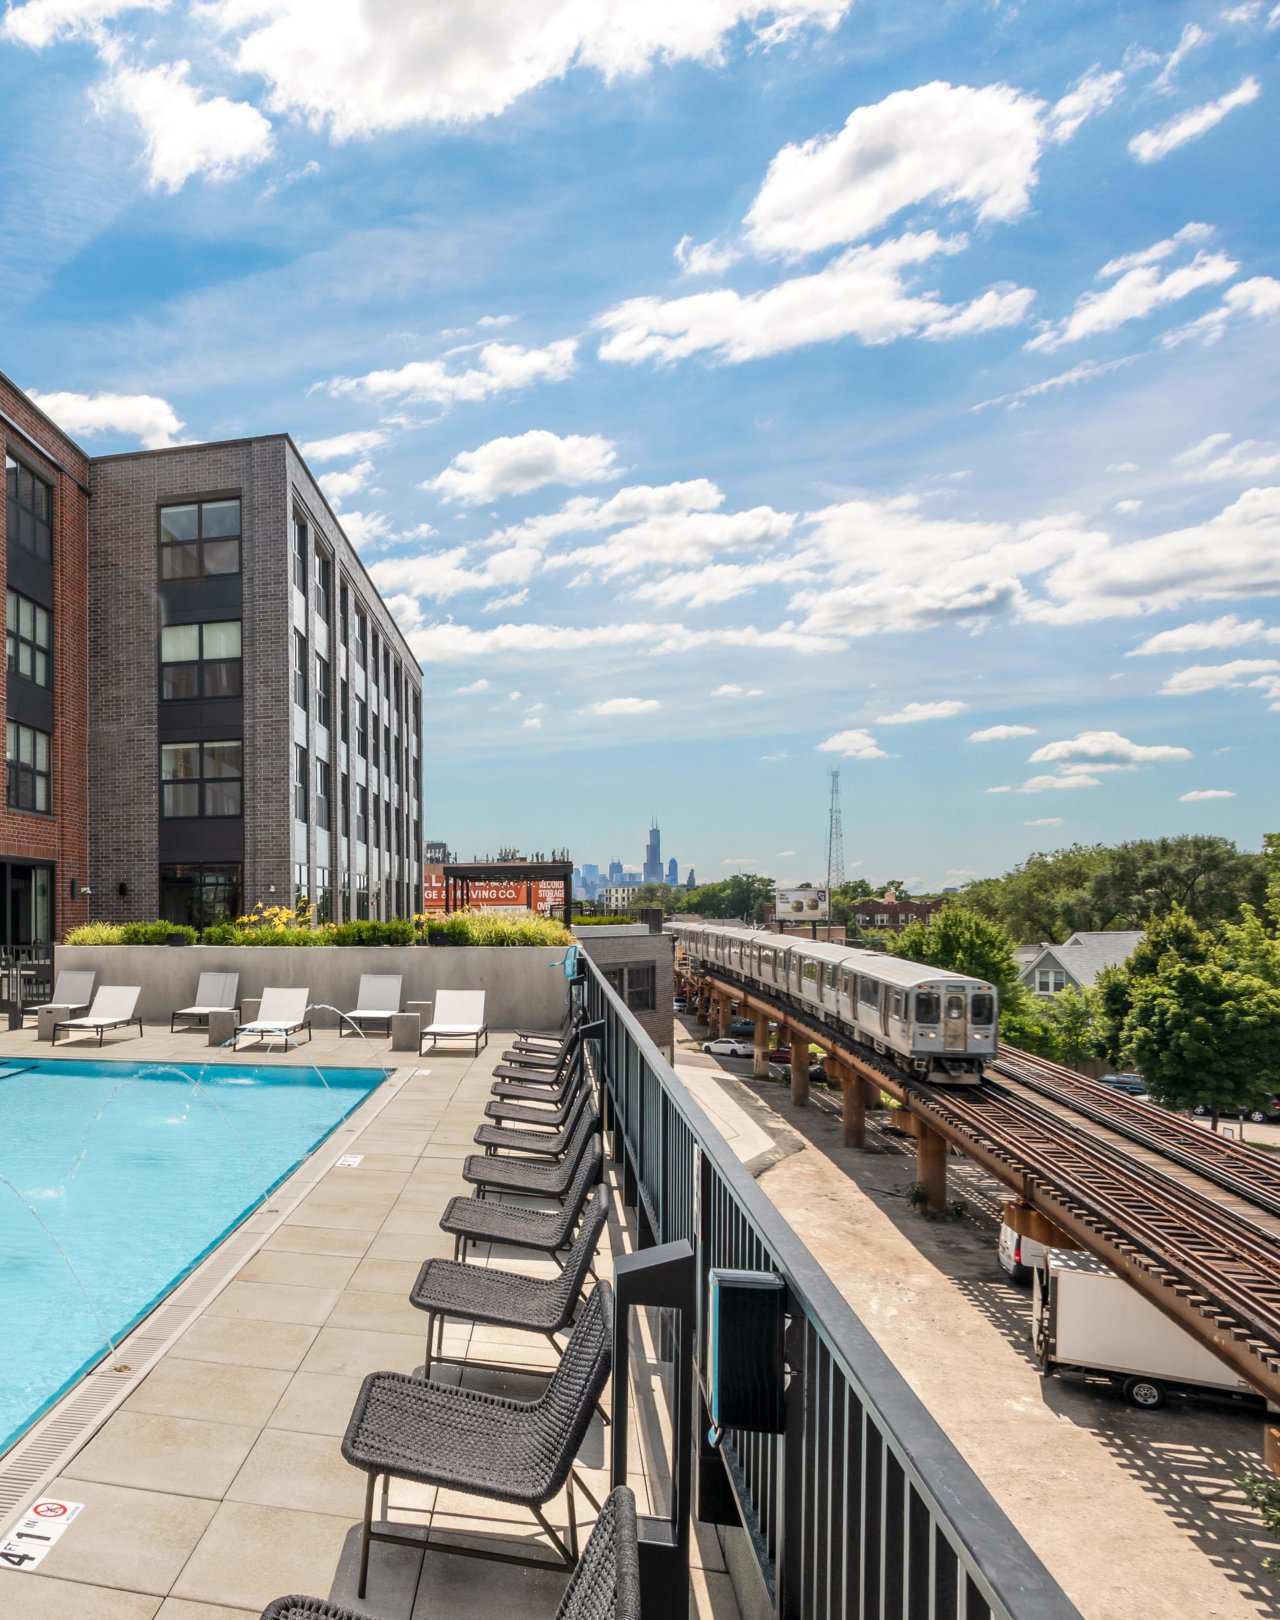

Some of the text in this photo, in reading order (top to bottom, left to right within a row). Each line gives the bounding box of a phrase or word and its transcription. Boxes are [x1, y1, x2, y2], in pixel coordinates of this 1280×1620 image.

[539, 880, 565, 889] RECORD
[498, 890, 518, 899] CO.
[22, 1519, 39, 1529] IN
[15, 1531, 52, 1542] 1
[3, 1542, 20, 1552] FT
